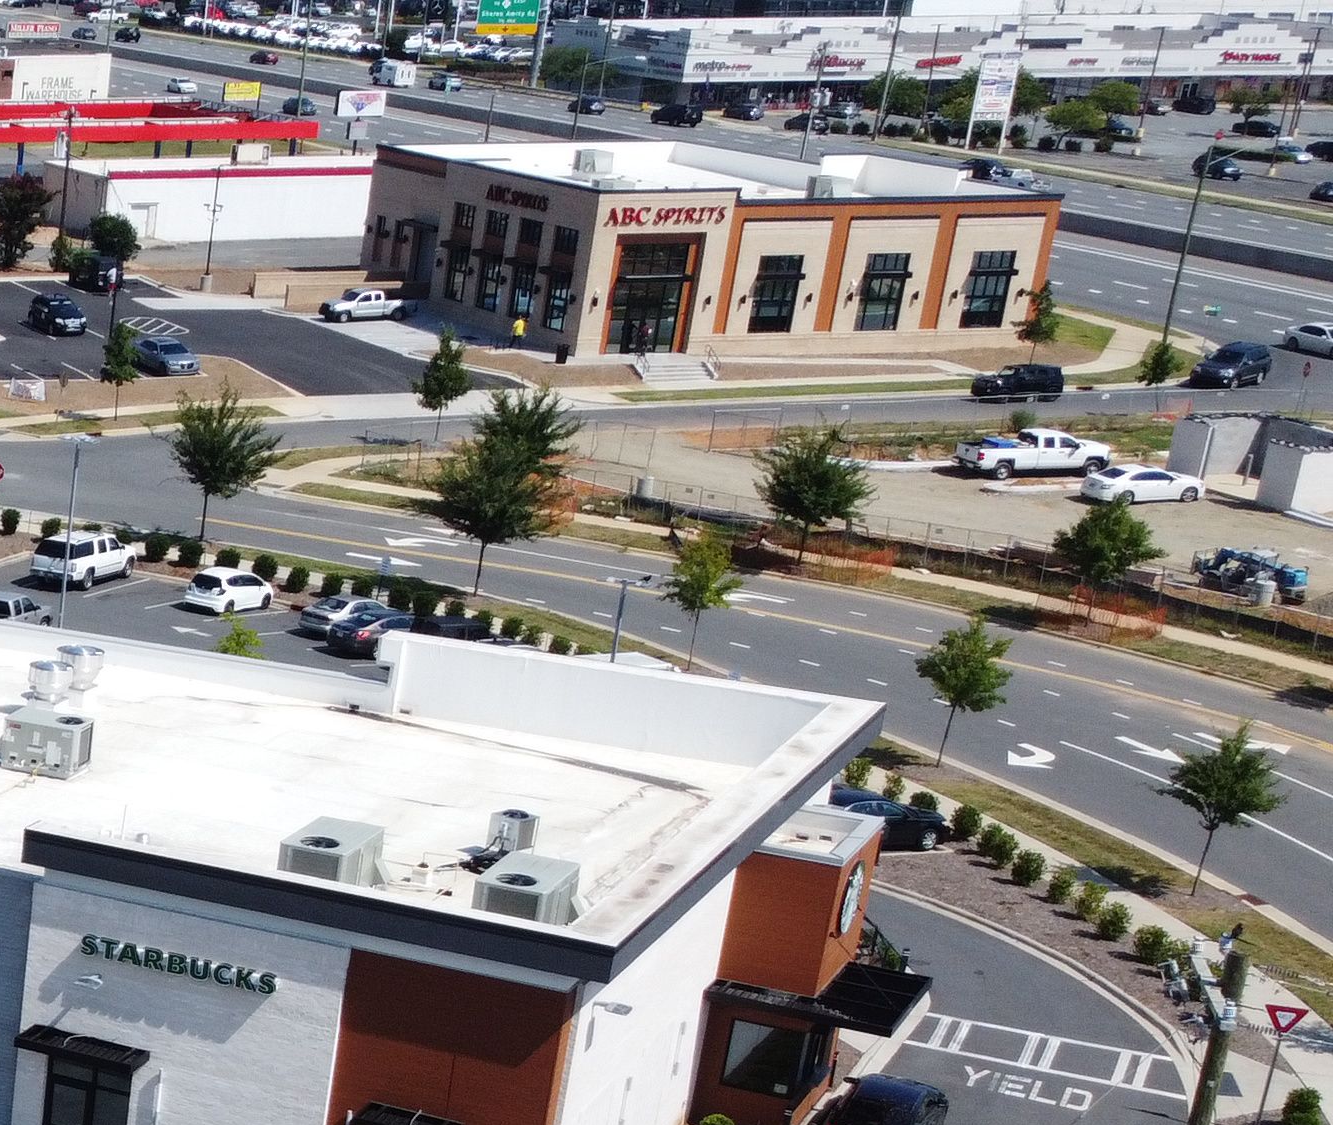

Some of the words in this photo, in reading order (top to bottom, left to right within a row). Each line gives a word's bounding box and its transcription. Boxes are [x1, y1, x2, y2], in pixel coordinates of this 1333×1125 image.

[10, 23, 35, 32] MILLER
[36, 23, 58, 32] PIANO
[41, 77, 74, 89] FRAME
[26, 90, 83, 100] WAREHOUSE
[486, 184, 513, 204] ABC
[603, 207, 652, 227] ABC
[653, 205, 727, 227] SPIRITS
[80, 933, 278, 996] STARBUCKS
[963, 1064, 1094, 1112] YIELD
